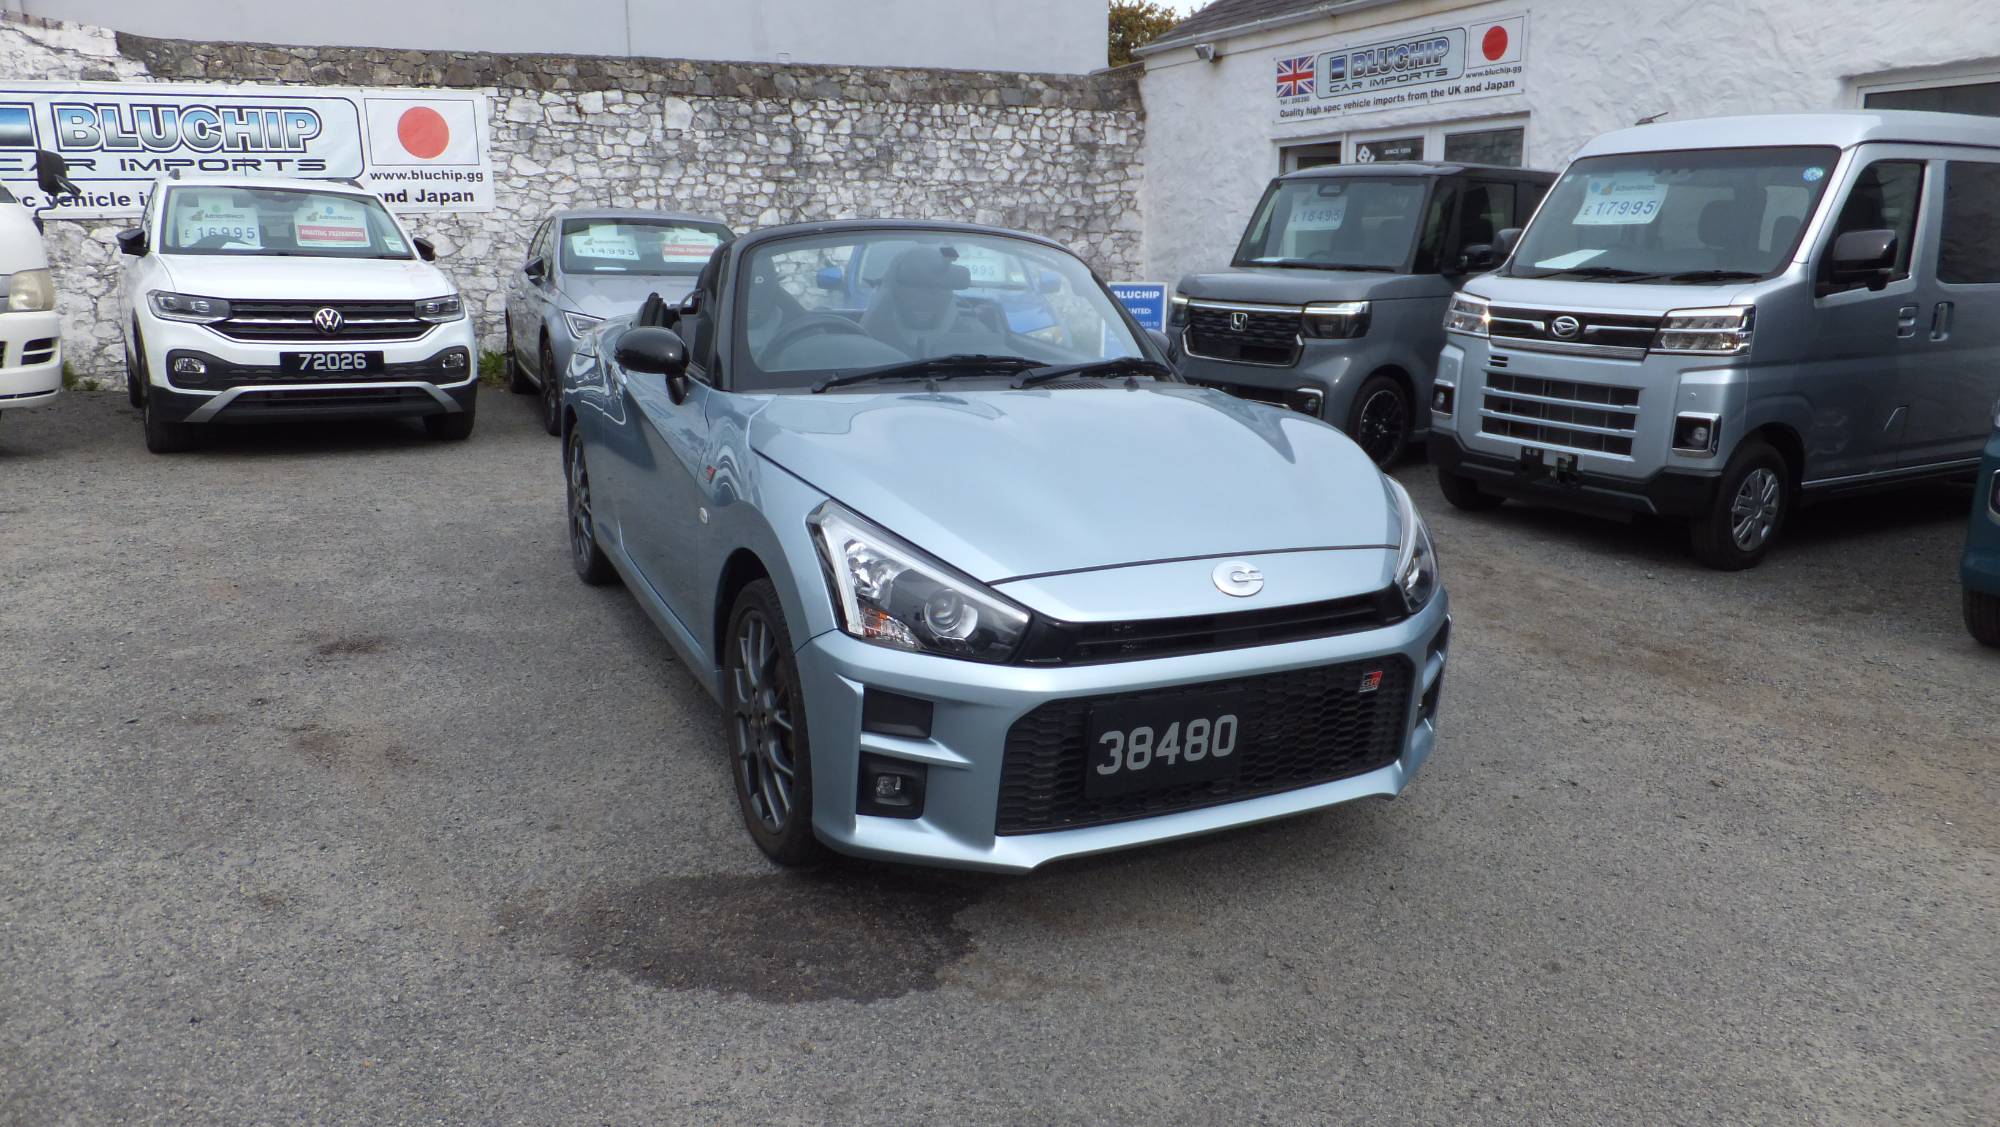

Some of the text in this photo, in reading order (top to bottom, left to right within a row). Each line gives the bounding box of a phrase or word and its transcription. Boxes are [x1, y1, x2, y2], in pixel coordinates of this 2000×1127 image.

[1351, 36, 1450, 79] BLUCHIP
[1329, 68, 1448, 93] CAR IMPORTS
[1465, 65, 1522, 79] www.bluchip.gg
[1280, 79, 1515, 118] Quality high spec vehicle imports from the UK and Japan
[50, 102, 322, 153] BLUCHIP
[120, 158, 327, 172] IMPORTS
[370, 171, 483, 183] www.bluchip.gg
[415, 189, 475, 206] Japan
[1596, 200, 1657, 215] 17995
[197, 226, 256, 239] 16995
[298, 353, 367, 370] 72026
[1096, 714, 1238, 775] 38480
